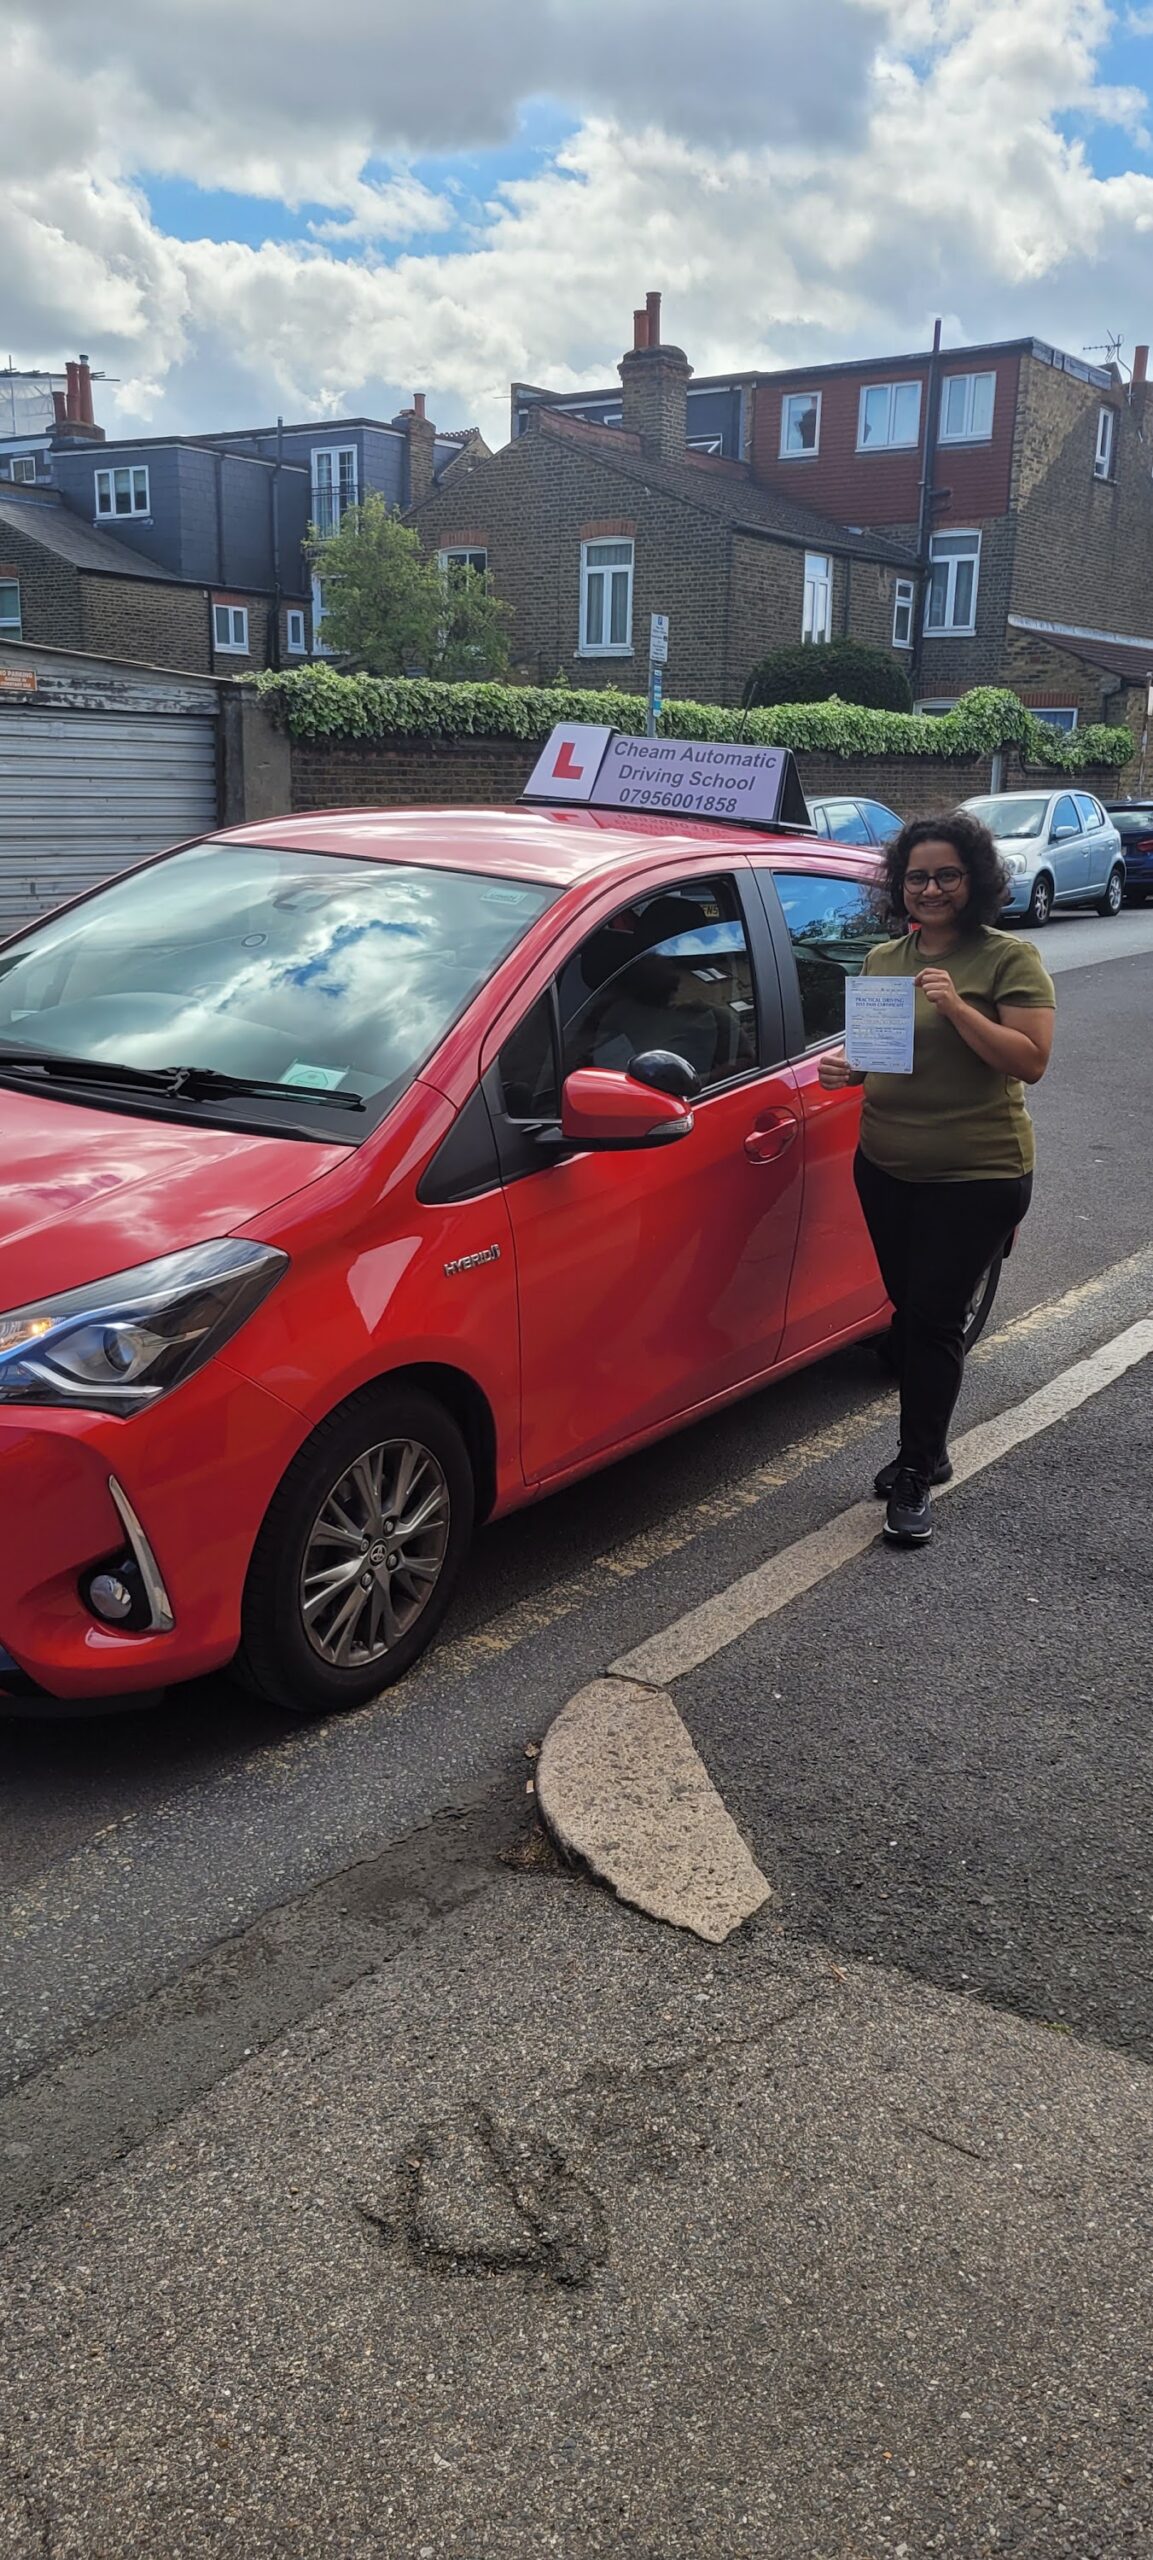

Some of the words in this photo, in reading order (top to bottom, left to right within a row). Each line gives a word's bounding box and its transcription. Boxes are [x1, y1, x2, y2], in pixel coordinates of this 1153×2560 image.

[7, 670, 33, 678] PARKING
[552, 742, 584, 780] L
[614, 741, 676, 761] Cheam
[680, 747, 777, 769] Automatic
[618, 764, 684, 788] Driving
[689, 770, 756, 791] School
[619, 788, 737, 813] 07956001858
[443, 1249, 492, 1277] HYBRID
